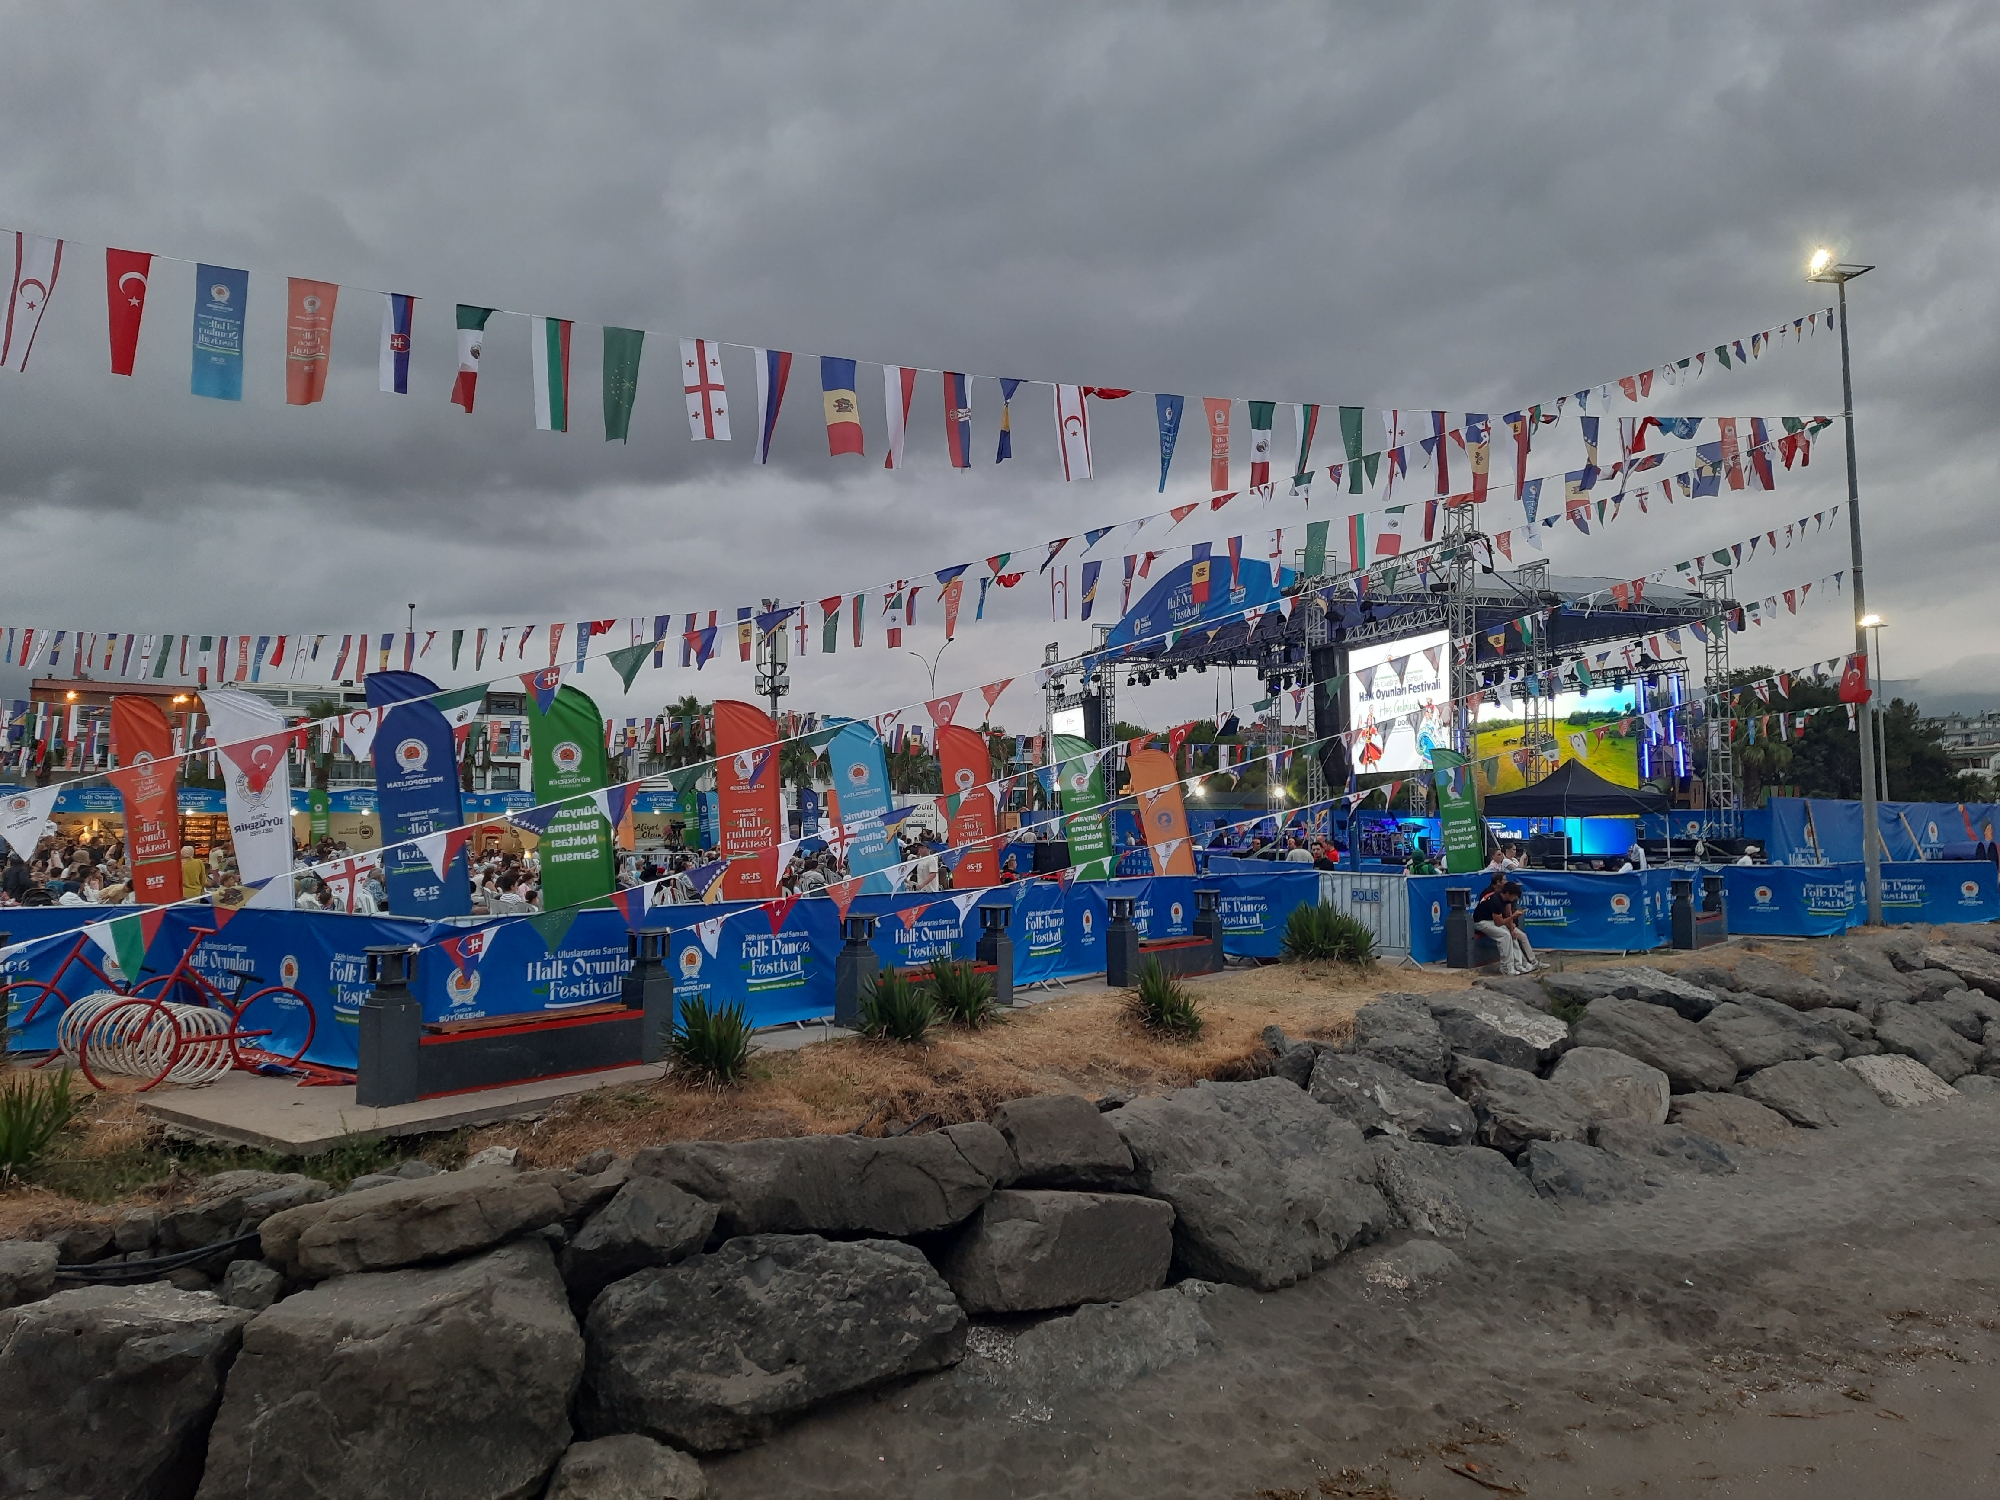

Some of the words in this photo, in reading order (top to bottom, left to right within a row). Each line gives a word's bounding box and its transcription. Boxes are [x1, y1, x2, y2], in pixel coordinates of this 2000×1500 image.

[1376, 685, 1407, 700] Oyunları
[1408, 679, 1441, 694] Festivali
[1351, 889, 1379, 901] POLİS
[1535, 895, 1572, 907] Dance
[1233, 901, 1268, 913] Dance
[1523, 907, 1564, 917] estival
[1025, 917, 1044, 931] Folk
[1044, 916, 1065, 928] Dance
[788, 930, 809, 938] Samsun
[894, 928, 919, 945] Halk
[1032, 929, 1062, 944] Festival
[557, 947, 601, 959] Uluslararası
[741, 940, 769, 959] Folk
[771, 939, 811, 953] Dance
[907, 940, 952, 959] Festivali
[329, 961, 357, 982] Folk
[526, 961, 568, 982] Halk
[572, 954, 636, 979] Oyunlar
[751, 955, 802, 977] Festival
[549, 976, 623, 1001] Festivali
